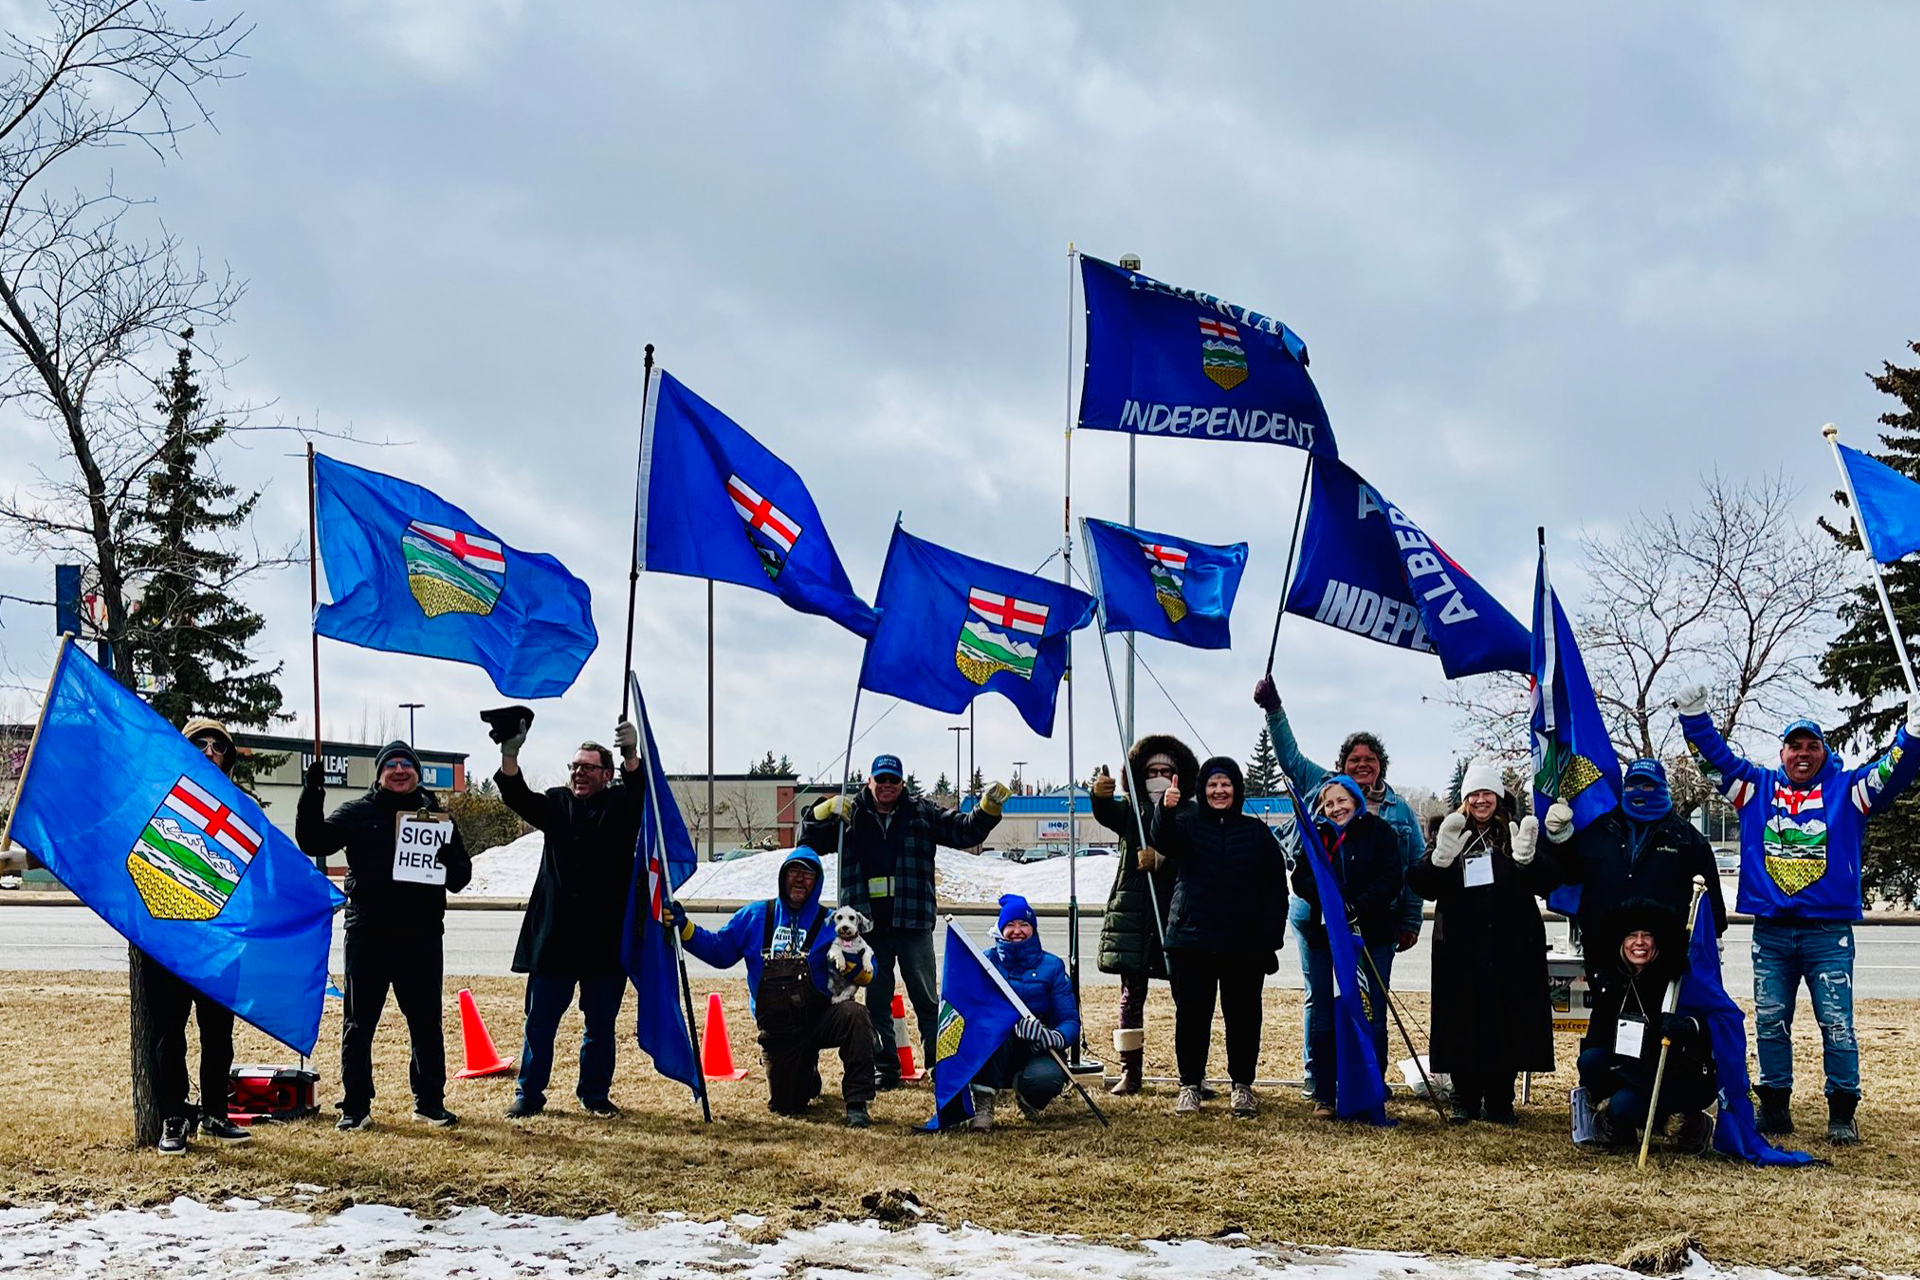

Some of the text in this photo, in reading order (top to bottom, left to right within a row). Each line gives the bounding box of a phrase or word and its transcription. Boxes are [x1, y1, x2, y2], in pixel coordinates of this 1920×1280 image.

[1119, 399, 1316, 449] INDEPENDENT
[1386, 501, 1479, 625] ALBER
[1314, 578, 1434, 653] INDEPE
[324, 755, 349, 774] LEAF
[401, 826, 446, 847] SIGN
[398, 850, 443, 870] HERE
